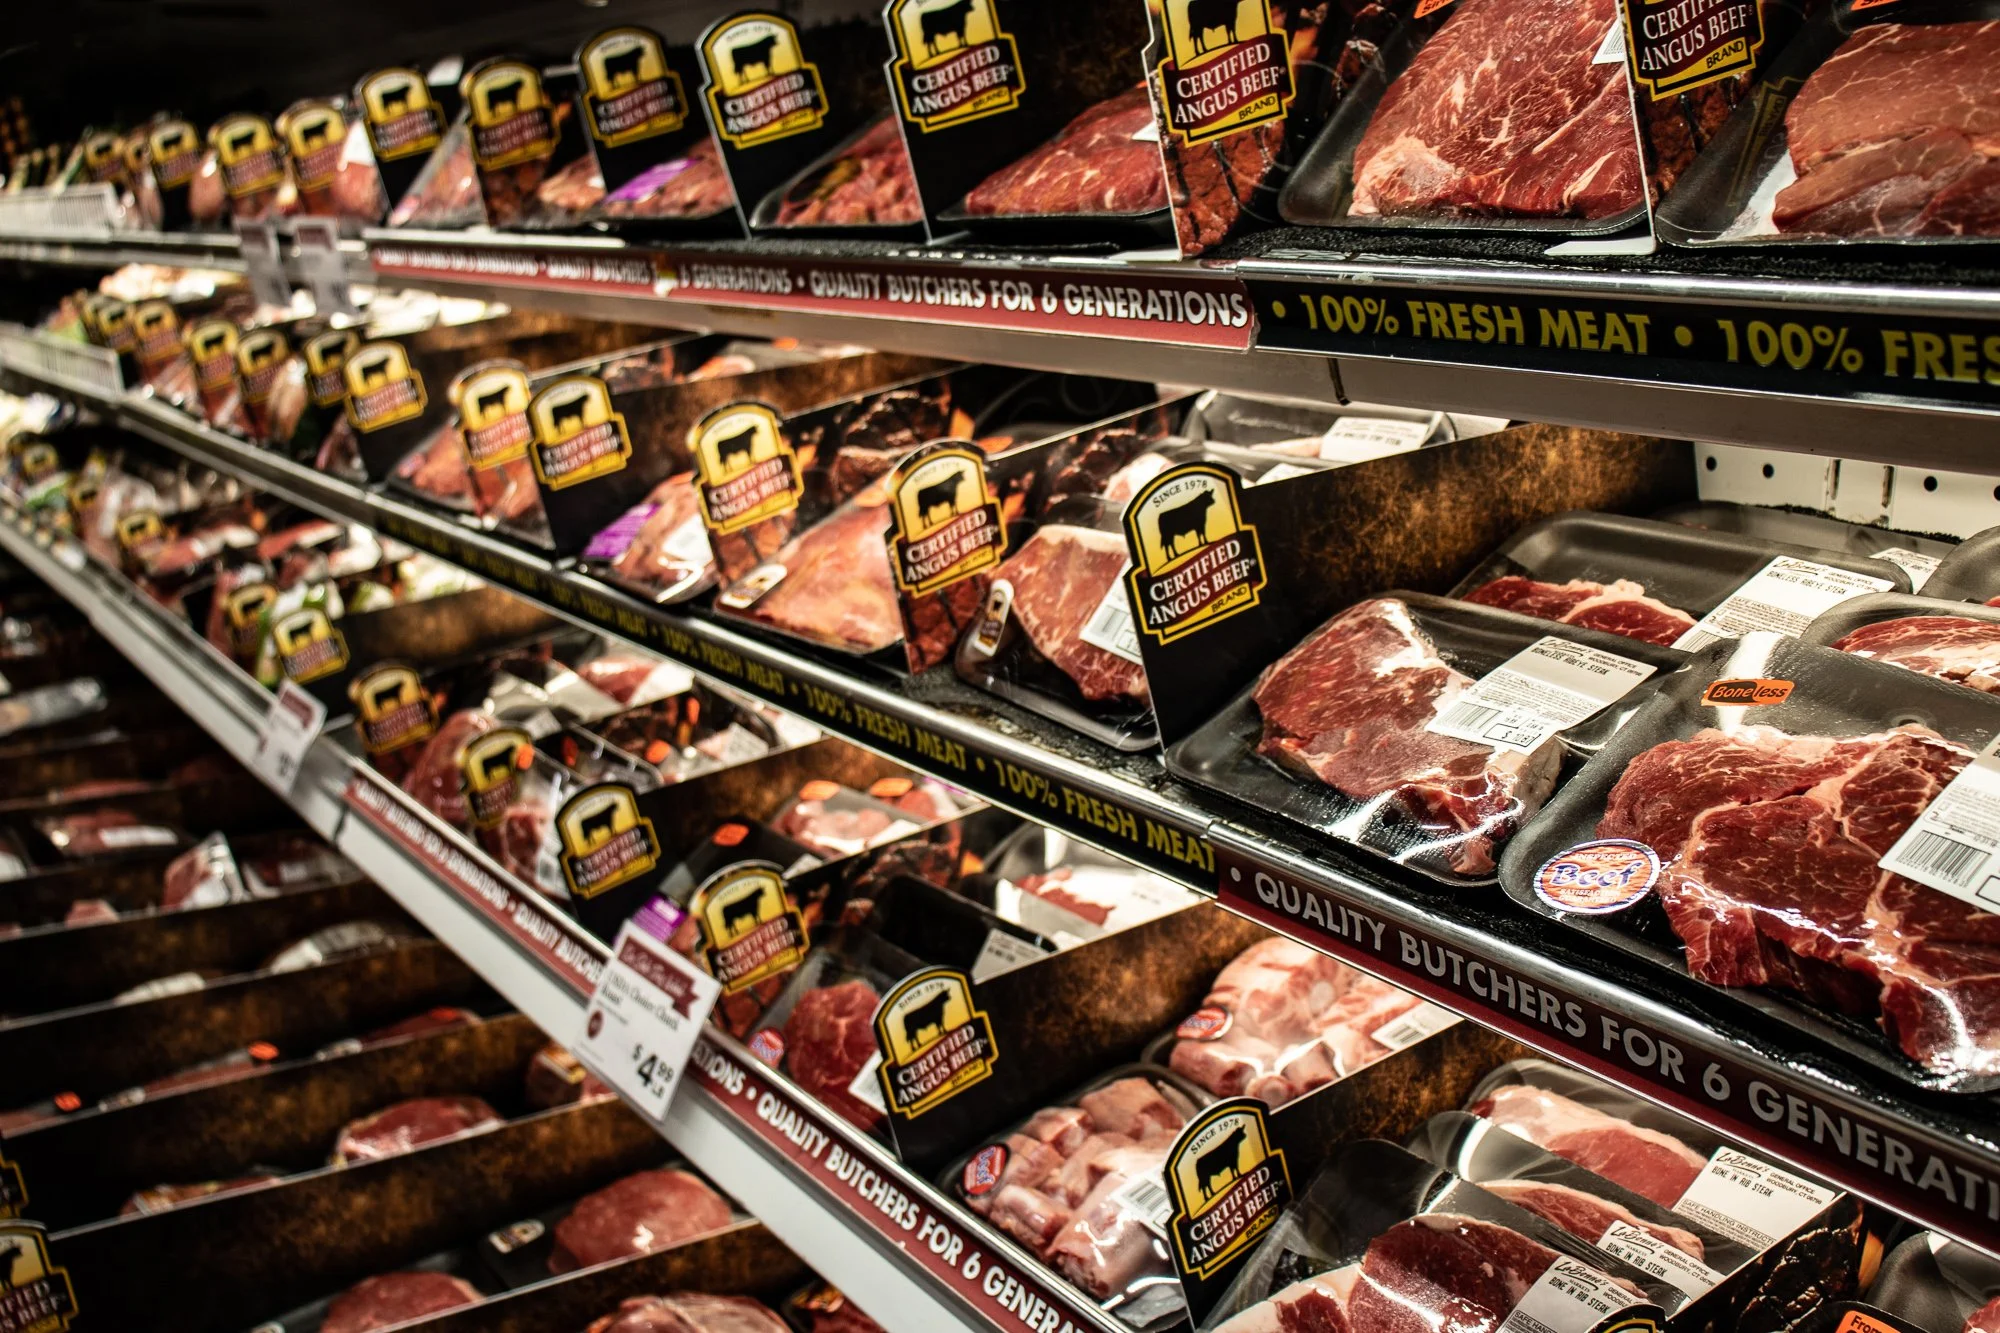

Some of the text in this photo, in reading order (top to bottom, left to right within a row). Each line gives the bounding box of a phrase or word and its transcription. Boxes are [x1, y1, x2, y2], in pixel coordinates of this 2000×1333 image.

[1643, 0, 1725, 39] CERTIF
[1641, 22, 1704, 71] ANGUS
[1706, 40, 1744, 69] BRAND
[912, 46, 999, 93] CERTIFIED
[1176, 42, 1270, 99] CERTIFIED
[912, 84, 971, 114] ANGUS
[1175, 85, 1238, 124] ANGUS
[1239, 95, 1276, 120] BRAND
[811, 270, 881, 301] QUALITY
[887, 275, 987, 308] BUTCHERS
[990, 280, 1036, 312] FOR
[1042, 284, 1058, 314] 6
[1063, 287, 1248, 328] GENERATIONS
[1300, 294, 1399, 335] 100%
[1407, 300, 1526, 345] FRESH
[1539, 307, 1650, 355] MEAT
[1716, 319, 1864, 374] 100%
[1152, 479, 1209, 508] SINCE 1978
[905, 509, 988, 563] CERTIFIED
[905, 547, 960, 583] ANGUS
[1149, 538, 1241, 603] CERTIFIED
[1149, 581, 1213, 626] ANGUS
[1210, 585, 1248, 613] BRAND
[1825, 585, 1847, 595] STEAK
[1531, 647, 1611, 676] BONELESS RIBEYE STEAK
[1593, 653, 1637, 669] GENERAL OFFICE
[1712, 681, 1789, 700] Boneless
[802, 683, 853, 724] 100%
[855, 705, 910, 750] FRESH
[914, 726, 966, 772] MEAT
[994, 759, 1059, 808] 100%
[1065, 788, 1140, 843] FRESH
[1146, 822, 1216, 874] MEAT
[1550, 860, 1645, 889] Beef
[1255, 872, 1386, 951] QUALITY
[1398, 930, 1587, 1039] BUTCHERS
[1600, 1015, 1685, 1084] FOR
[1702, 1063, 1731, 1101] 6
[896, 1024, 976, 1085] CERTIFIED
[898, 1061, 950, 1105] ANGUS
[1190, 1117, 1240, 1155] SINCE 1978
[756, 1092, 830, 1159] QUALITY
[825, 1143, 922, 1233] BUTCHERS
[917, 1214, 964, 1268] FOR
[962, 1251, 981, 1281] 6
[1711, 1166, 1729, 1179] BONE
[1730, 1173, 1737, 1183] IN
[1739, 1177, 1750, 1188] RIB
[1752, 1183, 1774, 1198] STEAK
[1766, 1178, 1797, 1195] WOODBURY,
[1798, 1190, 1807, 1198] CT
[1770, 1171, 1795, 1187] GENERAL
[1795, 1182, 1816, 1195] OFFICE
[1190, 1166, 1270, 1242] CERTIFIED
[1683, 1199, 1699, 1209] SAFE
[1700, 1206, 1736, 1227] HANDLING
[1190, 1211, 1245, 1264] ANGUS
[1244, 1207, 1278, 1239] BRAND
[1606, 1242, 1668, 1278] BONE IN RIB STEAK
[1659, 1254, 1691, 1275] WOODBURY,
[1691, 1270, 1699, 1278] CT
[1663, 1249, 1710, 1276] GENERAL OFFICE
[1548, 1276, 1612, 1315] BONE IN RIB STEAK
[1569, 1279, 1591, 1293] MARKETS
[1608, 1286, 1633, 1304] GENERAL
[1514, 1311, 1532, 1326] SAFE
